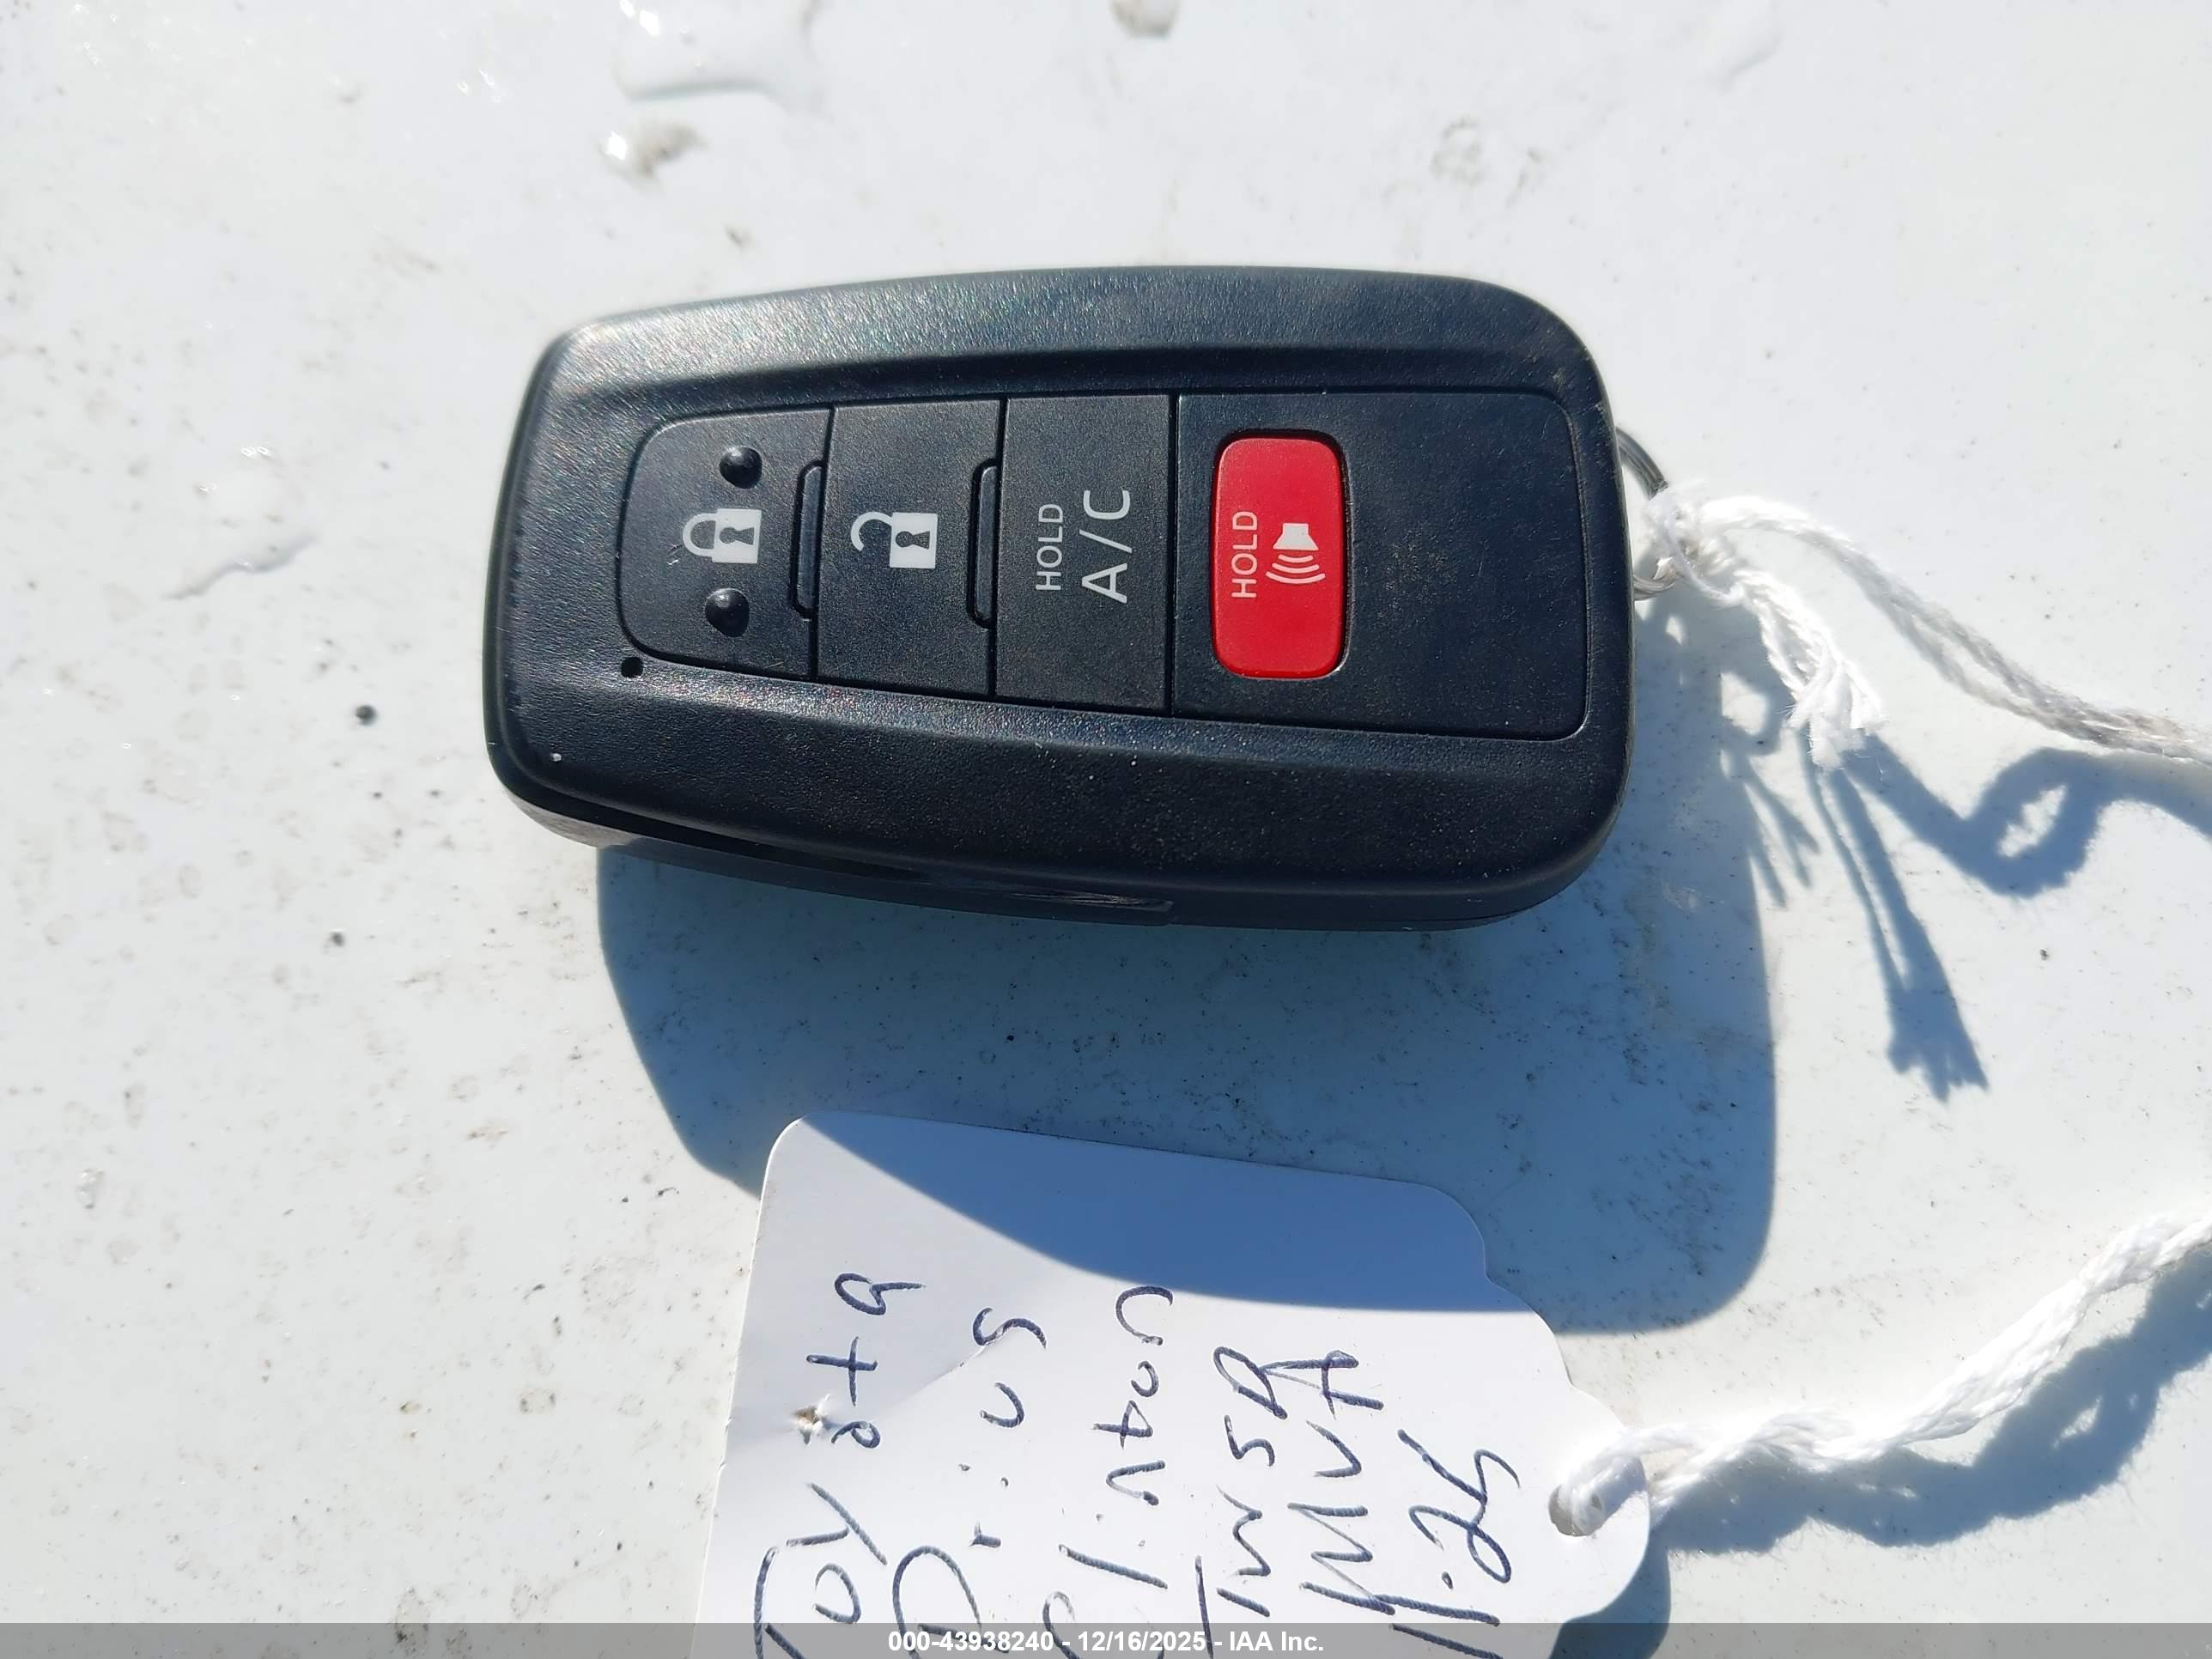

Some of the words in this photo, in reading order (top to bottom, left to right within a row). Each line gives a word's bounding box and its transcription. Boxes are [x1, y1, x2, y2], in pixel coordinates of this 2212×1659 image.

[1035, 502, 1064, 592] HOLD
[1079, 489, 1133, 605] A/C
[1231, 510, 1258, 599] HOLD
